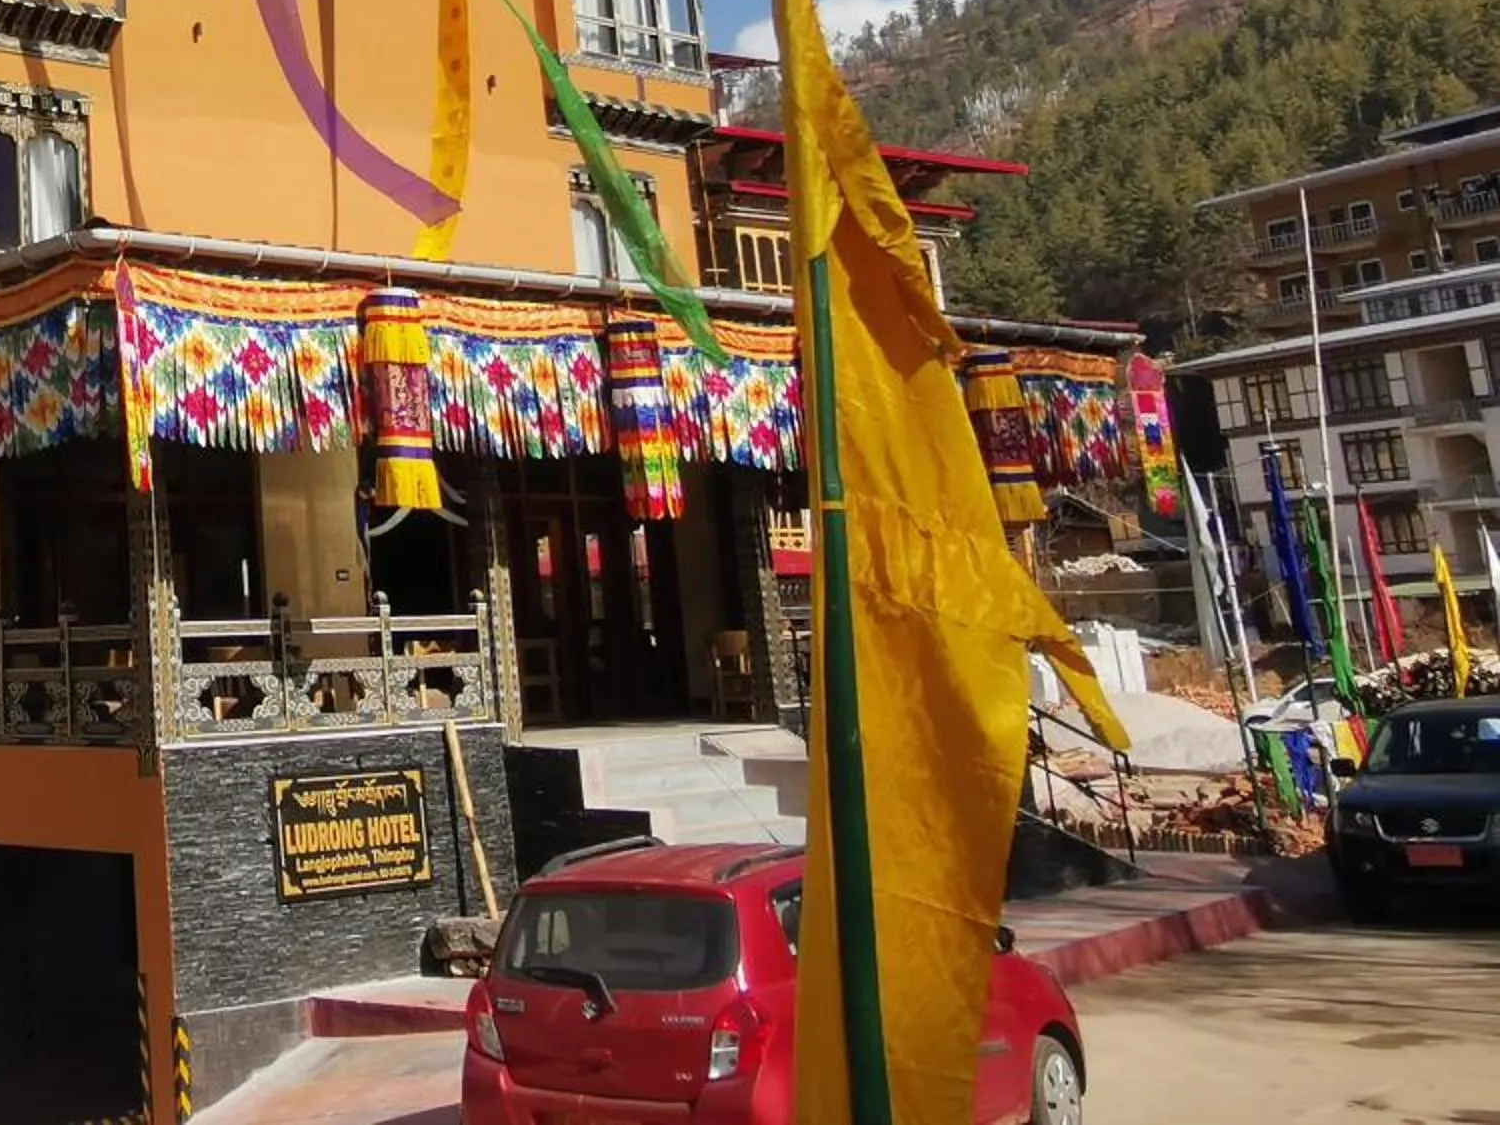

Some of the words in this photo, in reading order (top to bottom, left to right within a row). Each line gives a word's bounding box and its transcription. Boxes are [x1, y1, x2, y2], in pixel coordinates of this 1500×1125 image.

[285, 818, 365, 855] LUDRONG
[367, 813, 421, 846] HOTEL
[371, 847, 415, 865] Thimphu
